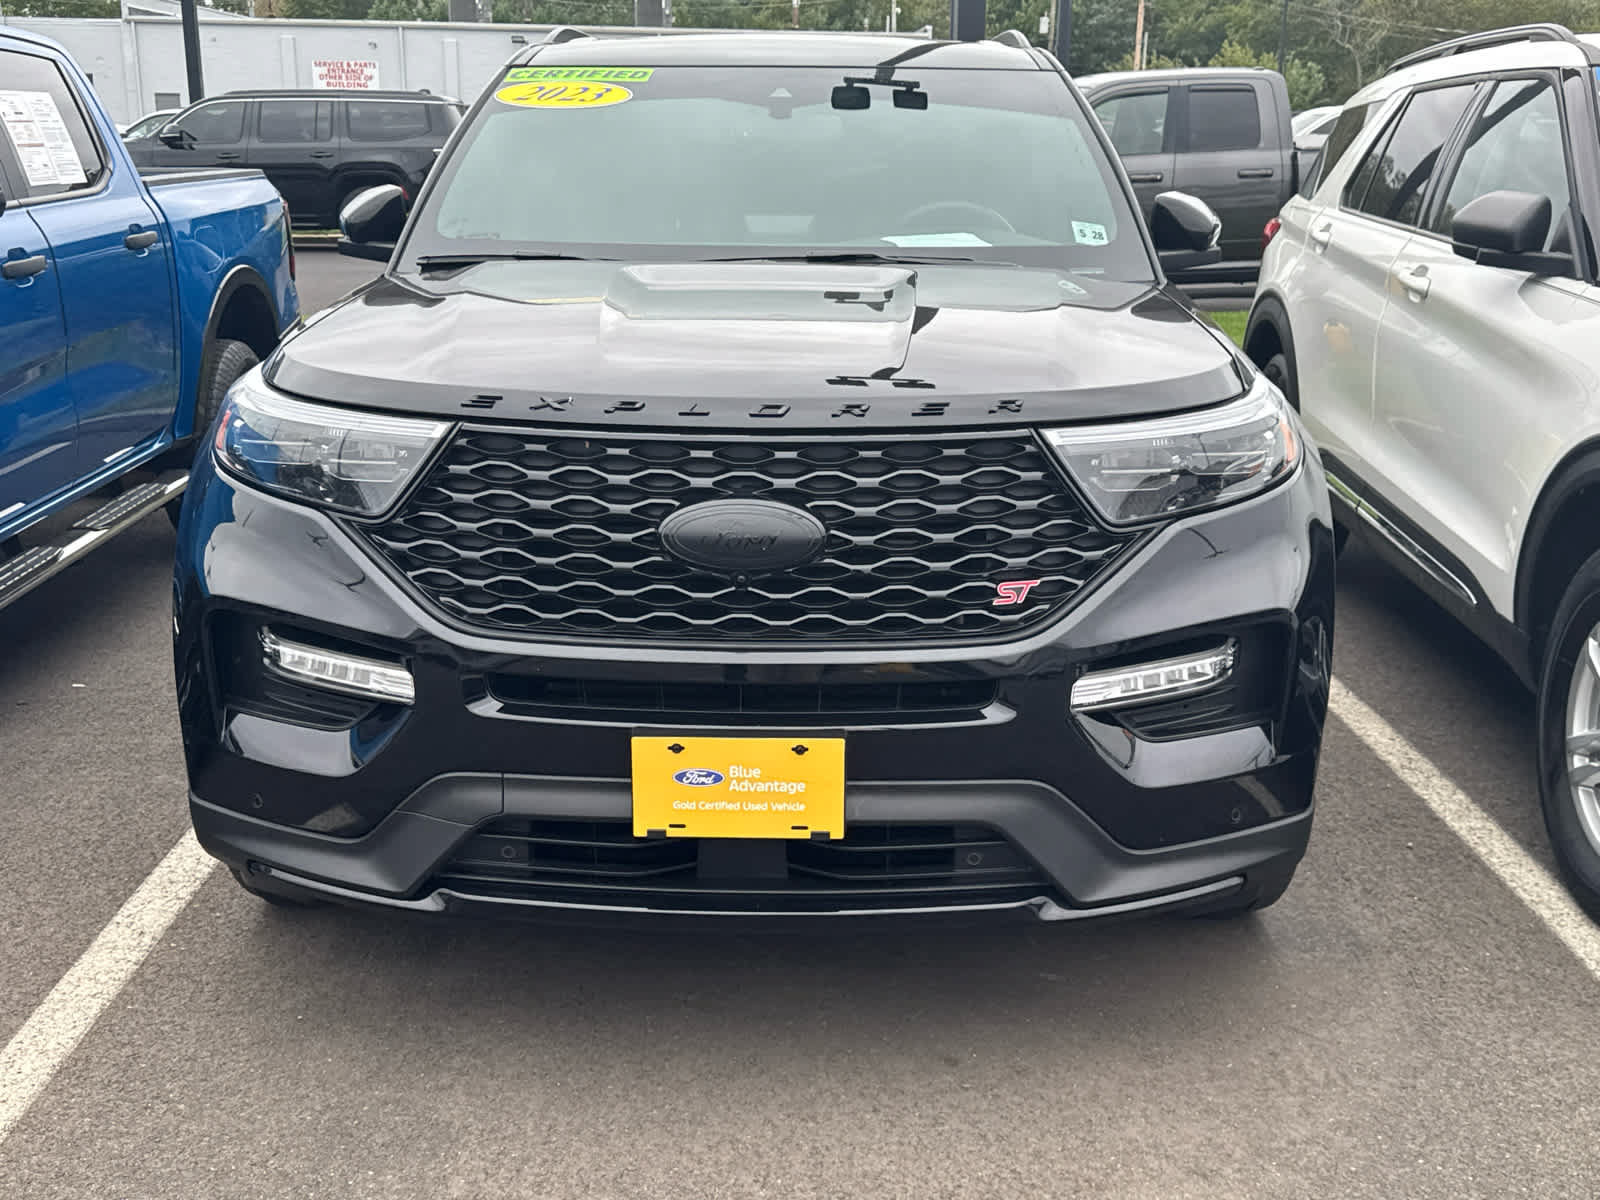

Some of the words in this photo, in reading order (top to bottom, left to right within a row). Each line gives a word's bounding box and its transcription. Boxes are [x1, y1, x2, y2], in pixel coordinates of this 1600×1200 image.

[353, 61, 377, 69] PARTS
[509, 69, 648, 80] CERTIFIED
[512, 86, 612, 102] 2023
[460, 394, 1024, 418] EXPLORER
[992, 579, 1041, 606] ST
[682, 770, 716, 785] Ford
[729, 765, 761, 778] Blue
[728, 780, 806, 794] Advantage
[672, 800, 697, 810] Gold
[698, 800, 740, 811] Certified
[742, 801, 768, 811] Used
[770, 802, 806, 812] Vehicle
